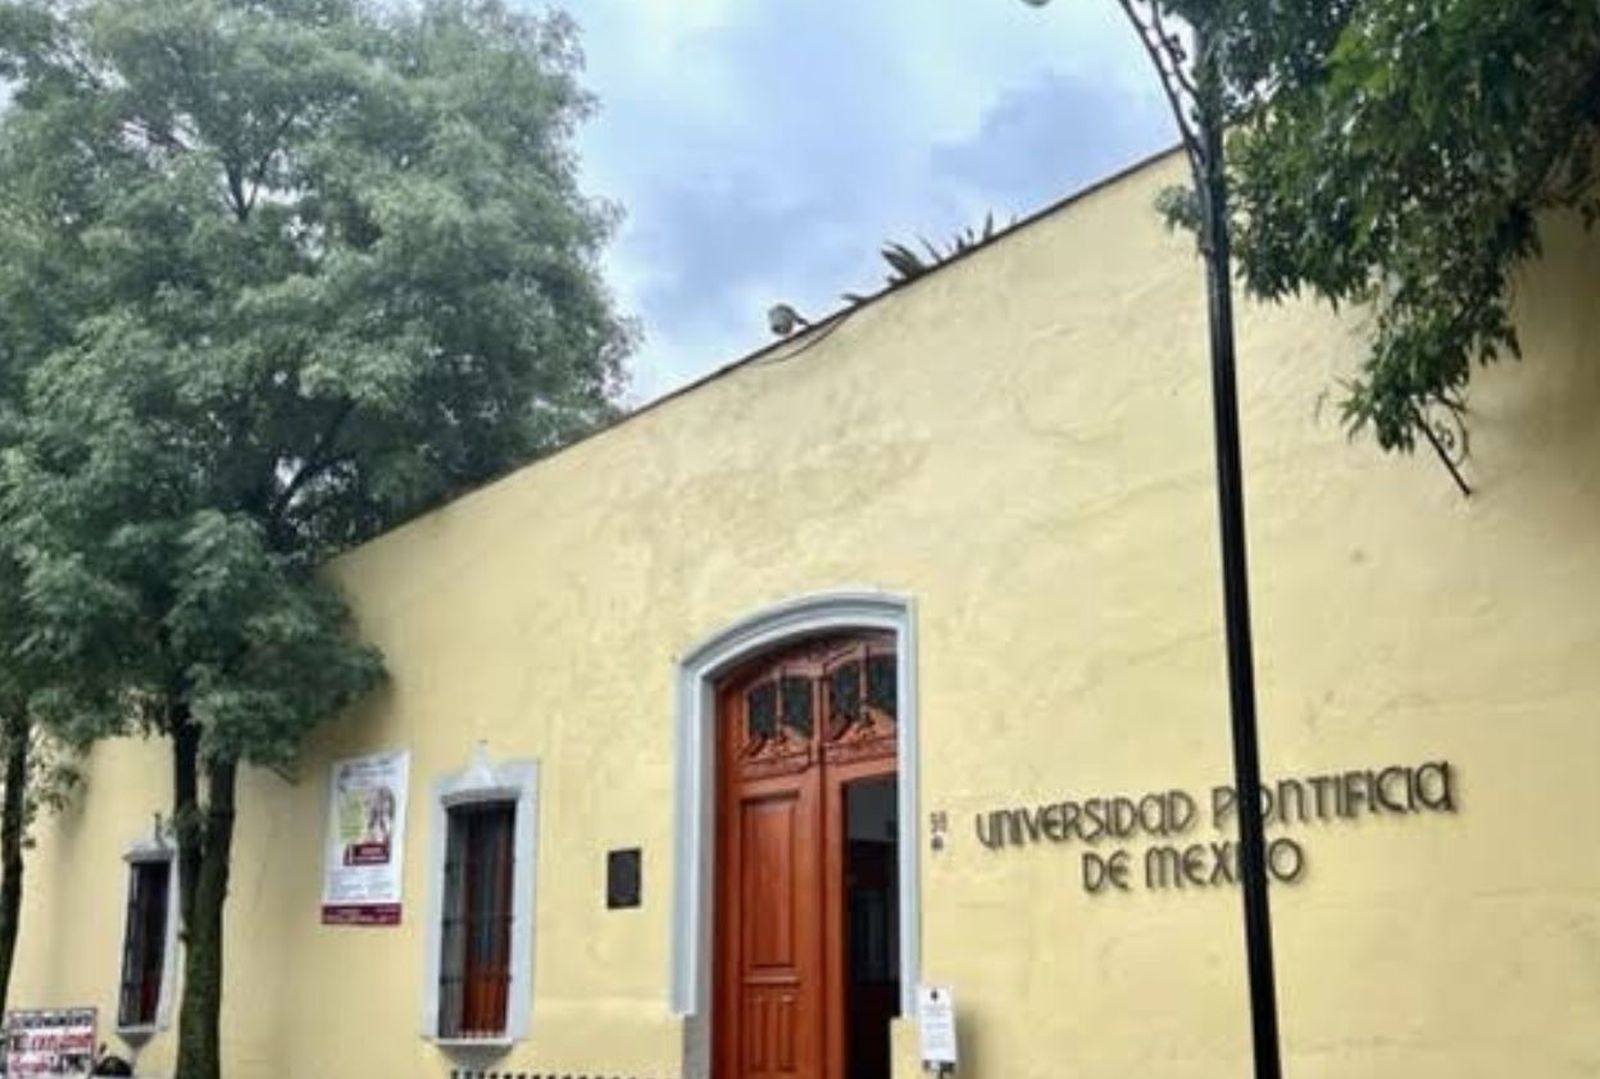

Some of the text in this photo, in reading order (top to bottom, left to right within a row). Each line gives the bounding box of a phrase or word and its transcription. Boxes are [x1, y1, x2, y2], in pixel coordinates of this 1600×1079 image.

[976, 789, 1197, 848] UNIVERSIDAD
[1081, 837, 1304, 893] DE MEXIO
